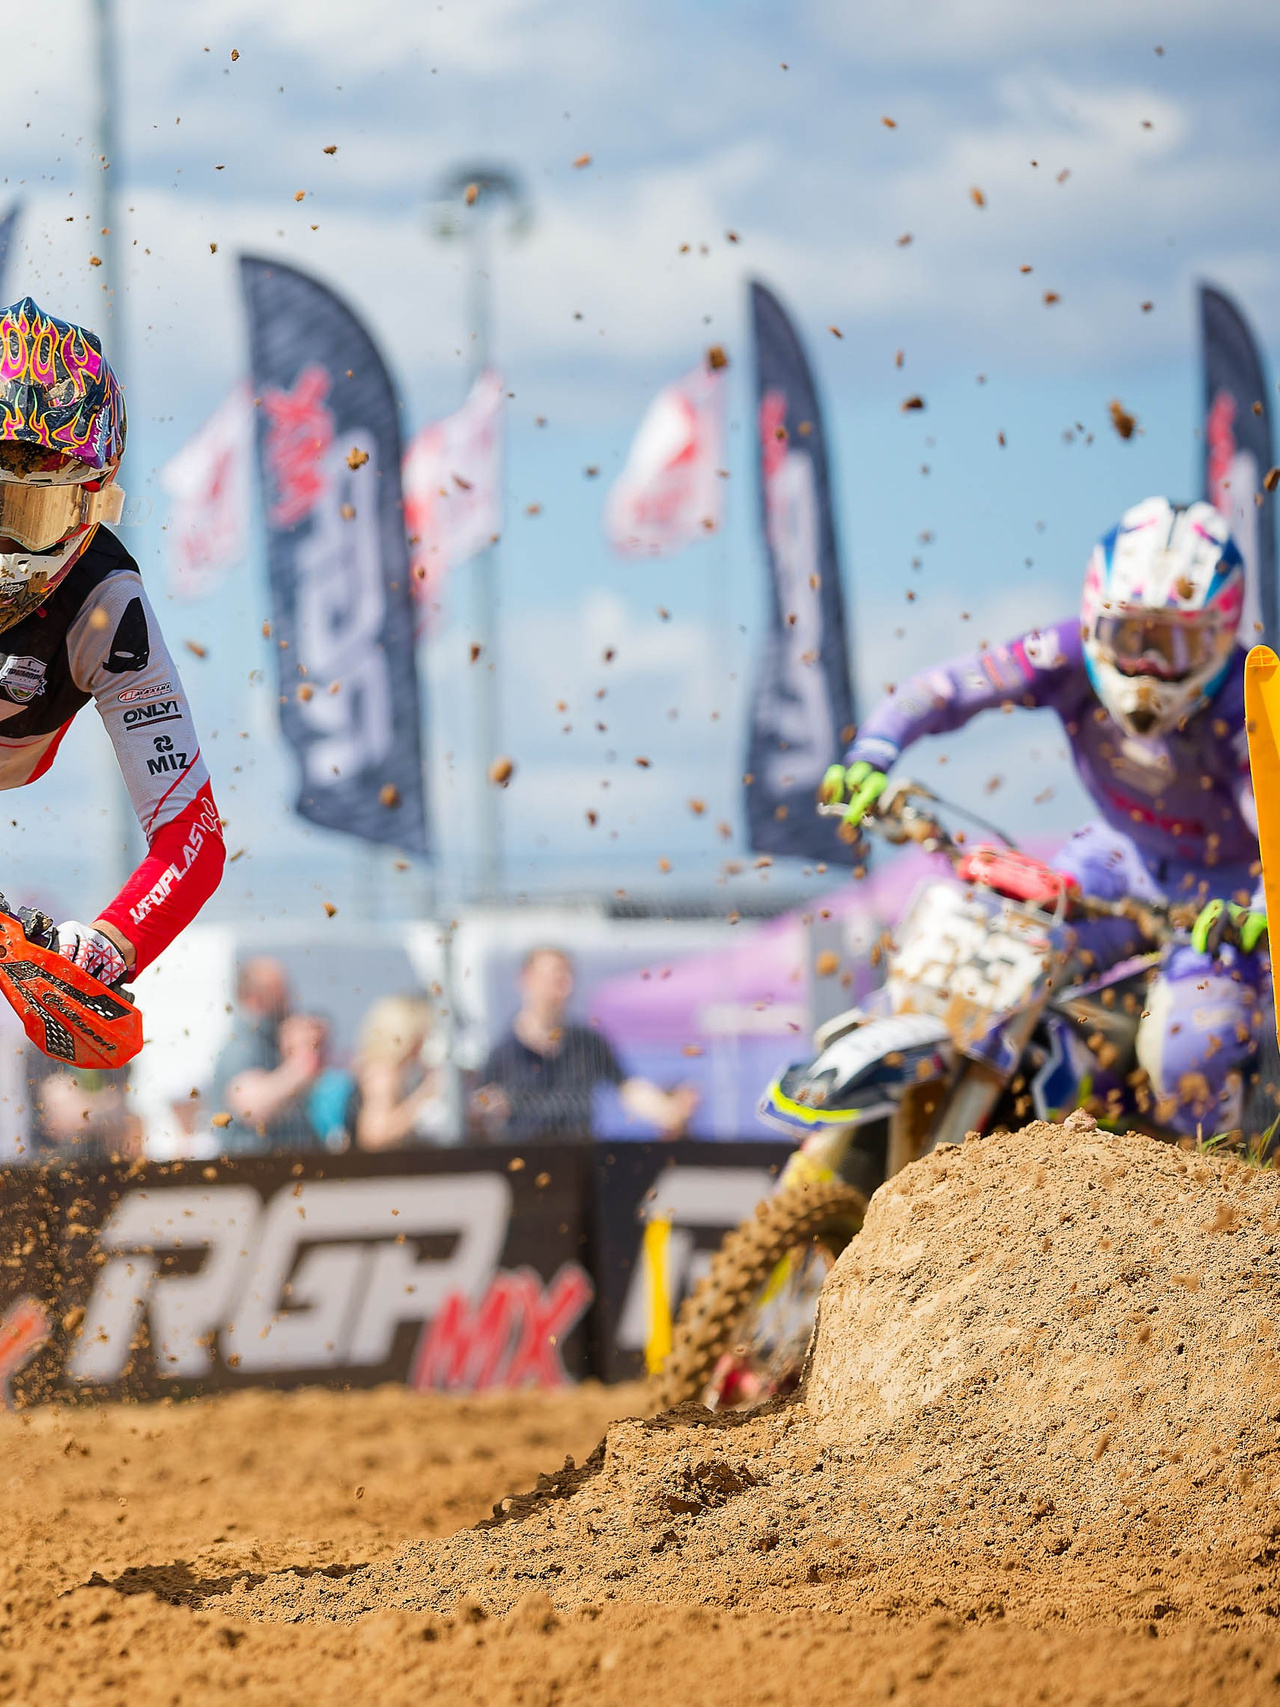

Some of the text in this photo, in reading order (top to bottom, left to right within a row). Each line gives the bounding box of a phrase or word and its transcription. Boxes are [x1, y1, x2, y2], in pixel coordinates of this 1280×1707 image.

[146, 753, 191, 776] MIZ
[69, 1171, 510, 1382] RGP
[410, 1263, 594, 1389] MX
